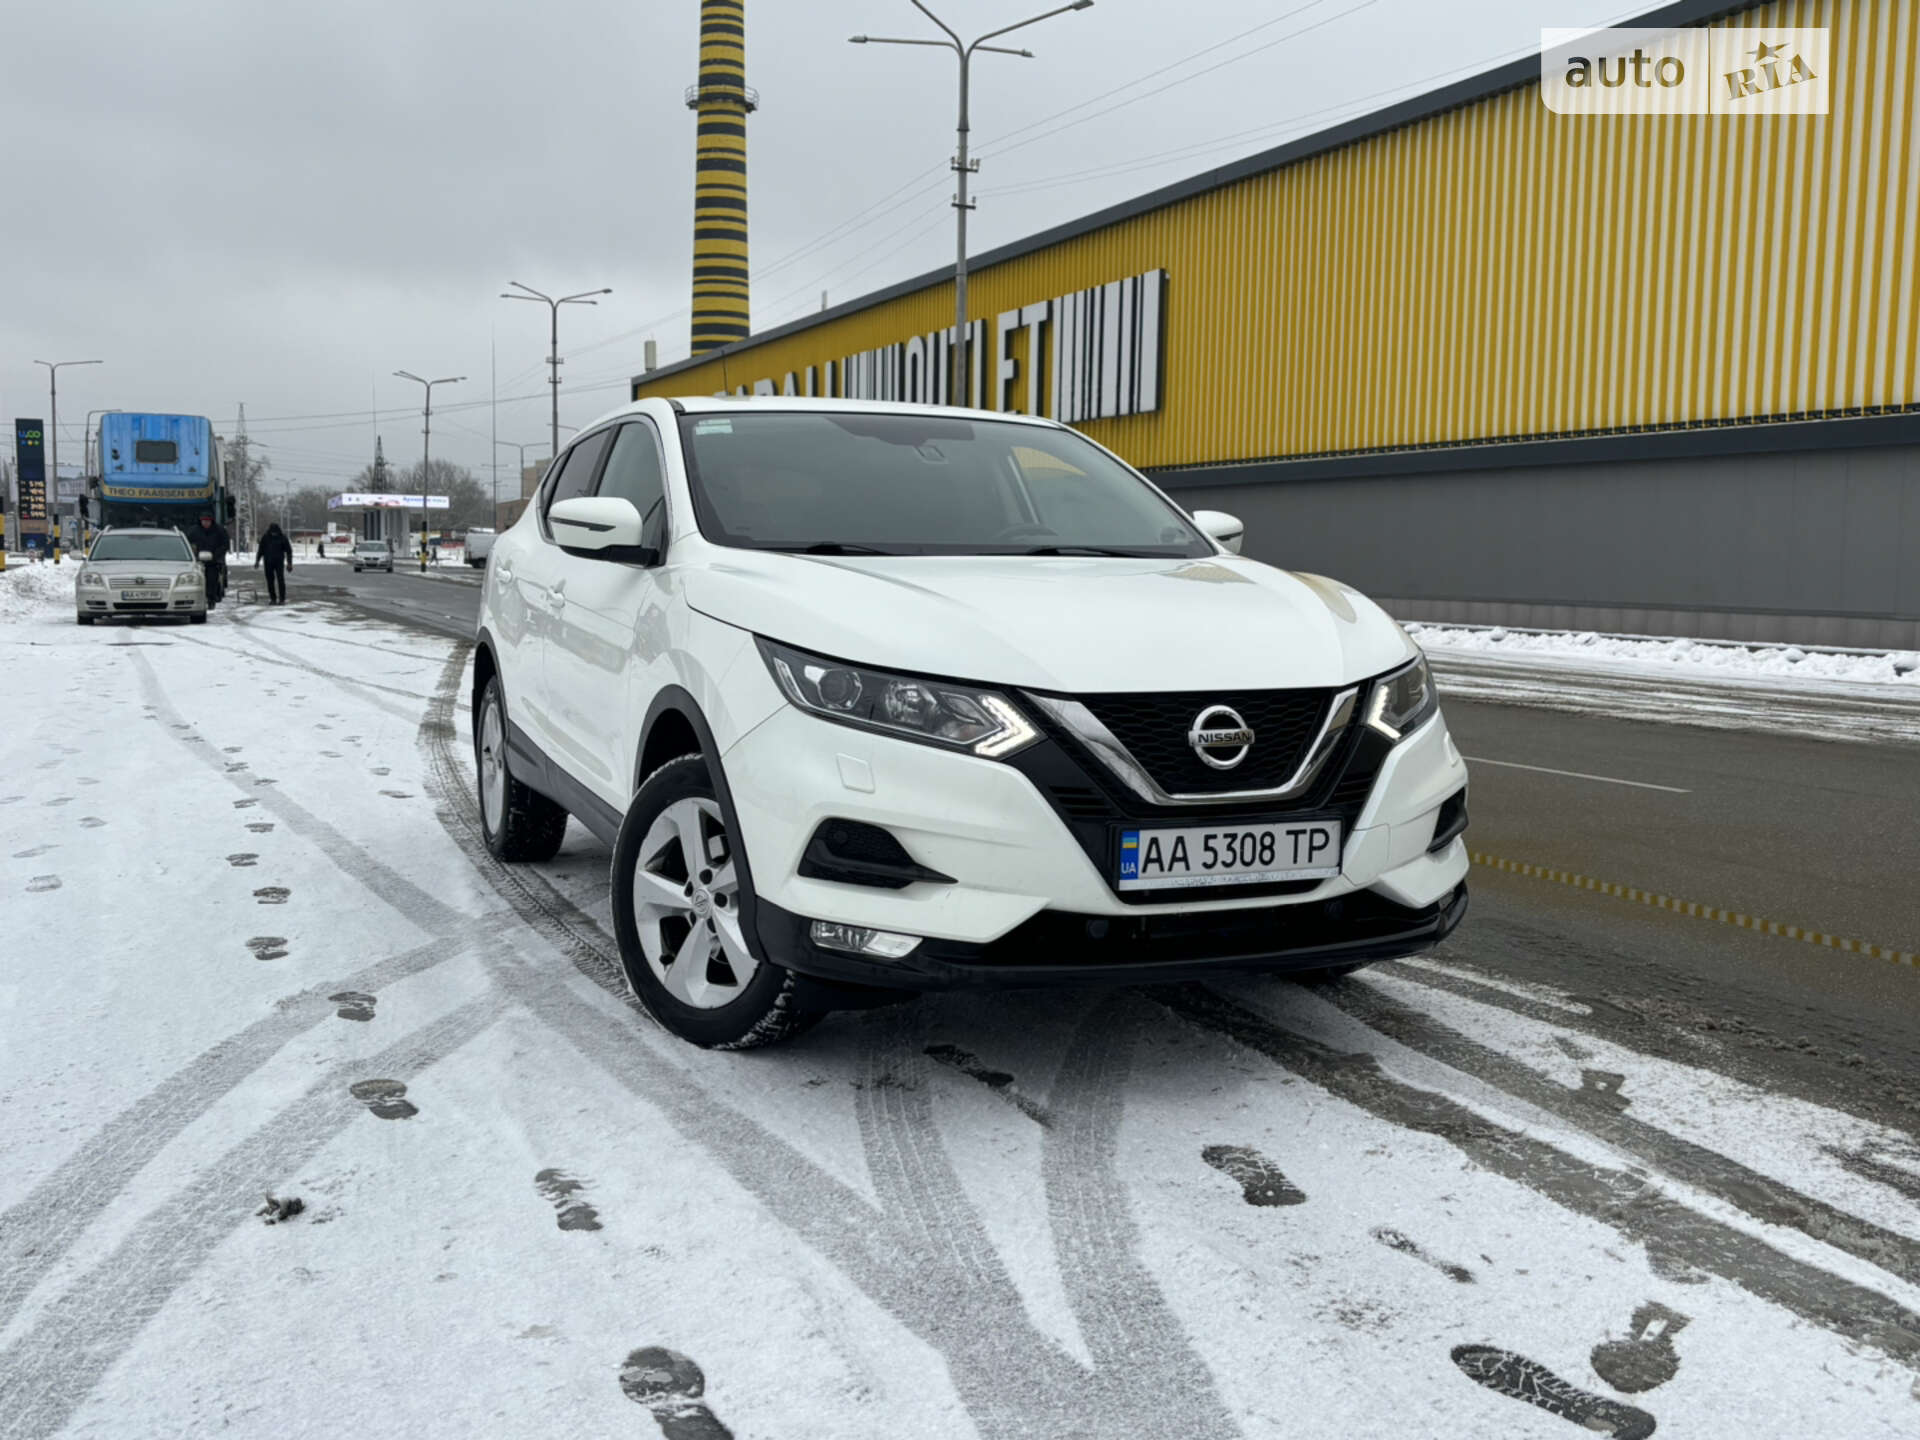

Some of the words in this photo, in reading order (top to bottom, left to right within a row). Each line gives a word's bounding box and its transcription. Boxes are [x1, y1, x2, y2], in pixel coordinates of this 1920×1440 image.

[1197, 730, 1253, 744] NISSAN
[1141, 835, 1191, 874] AA
[1201, 831, 1276, 870] 5308
[1285, 828, 1331, 866] TP
[1121, 861, 1137, 875] UA
